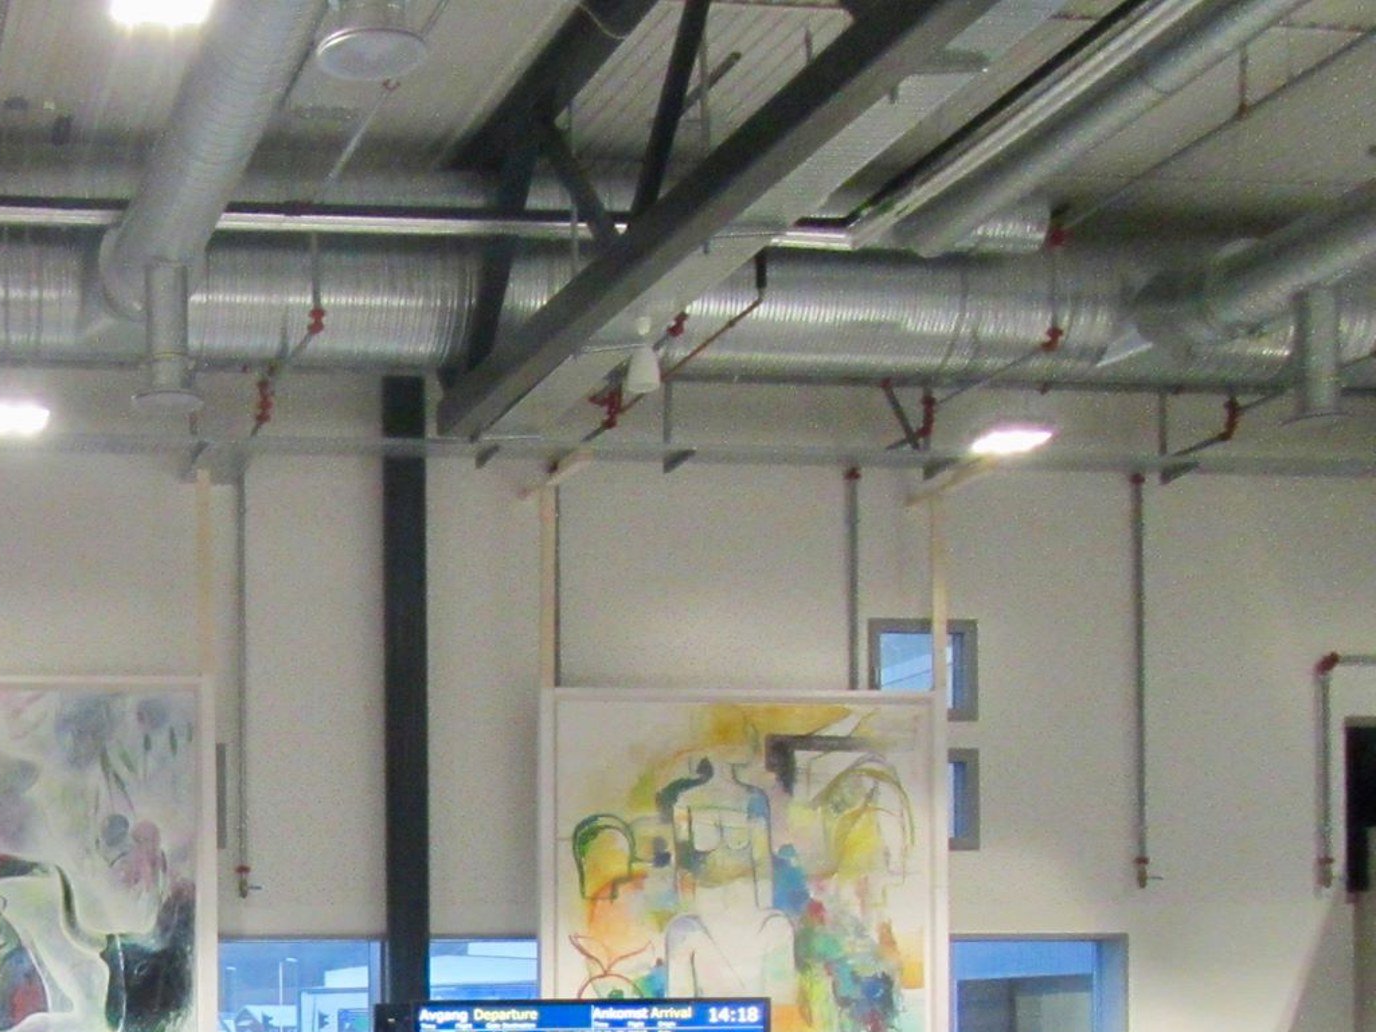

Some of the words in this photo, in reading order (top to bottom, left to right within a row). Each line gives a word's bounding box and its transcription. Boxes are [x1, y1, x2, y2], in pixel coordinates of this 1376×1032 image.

[420, 1009, 469, 1023] Avgang
[474, 1009, 538, 1022] Departure
[593, 1008, 648, 1019] Ankomst
[651, 1006, 692, 1018] Arrival
[709, 1007, 759, 1022] 14:18
